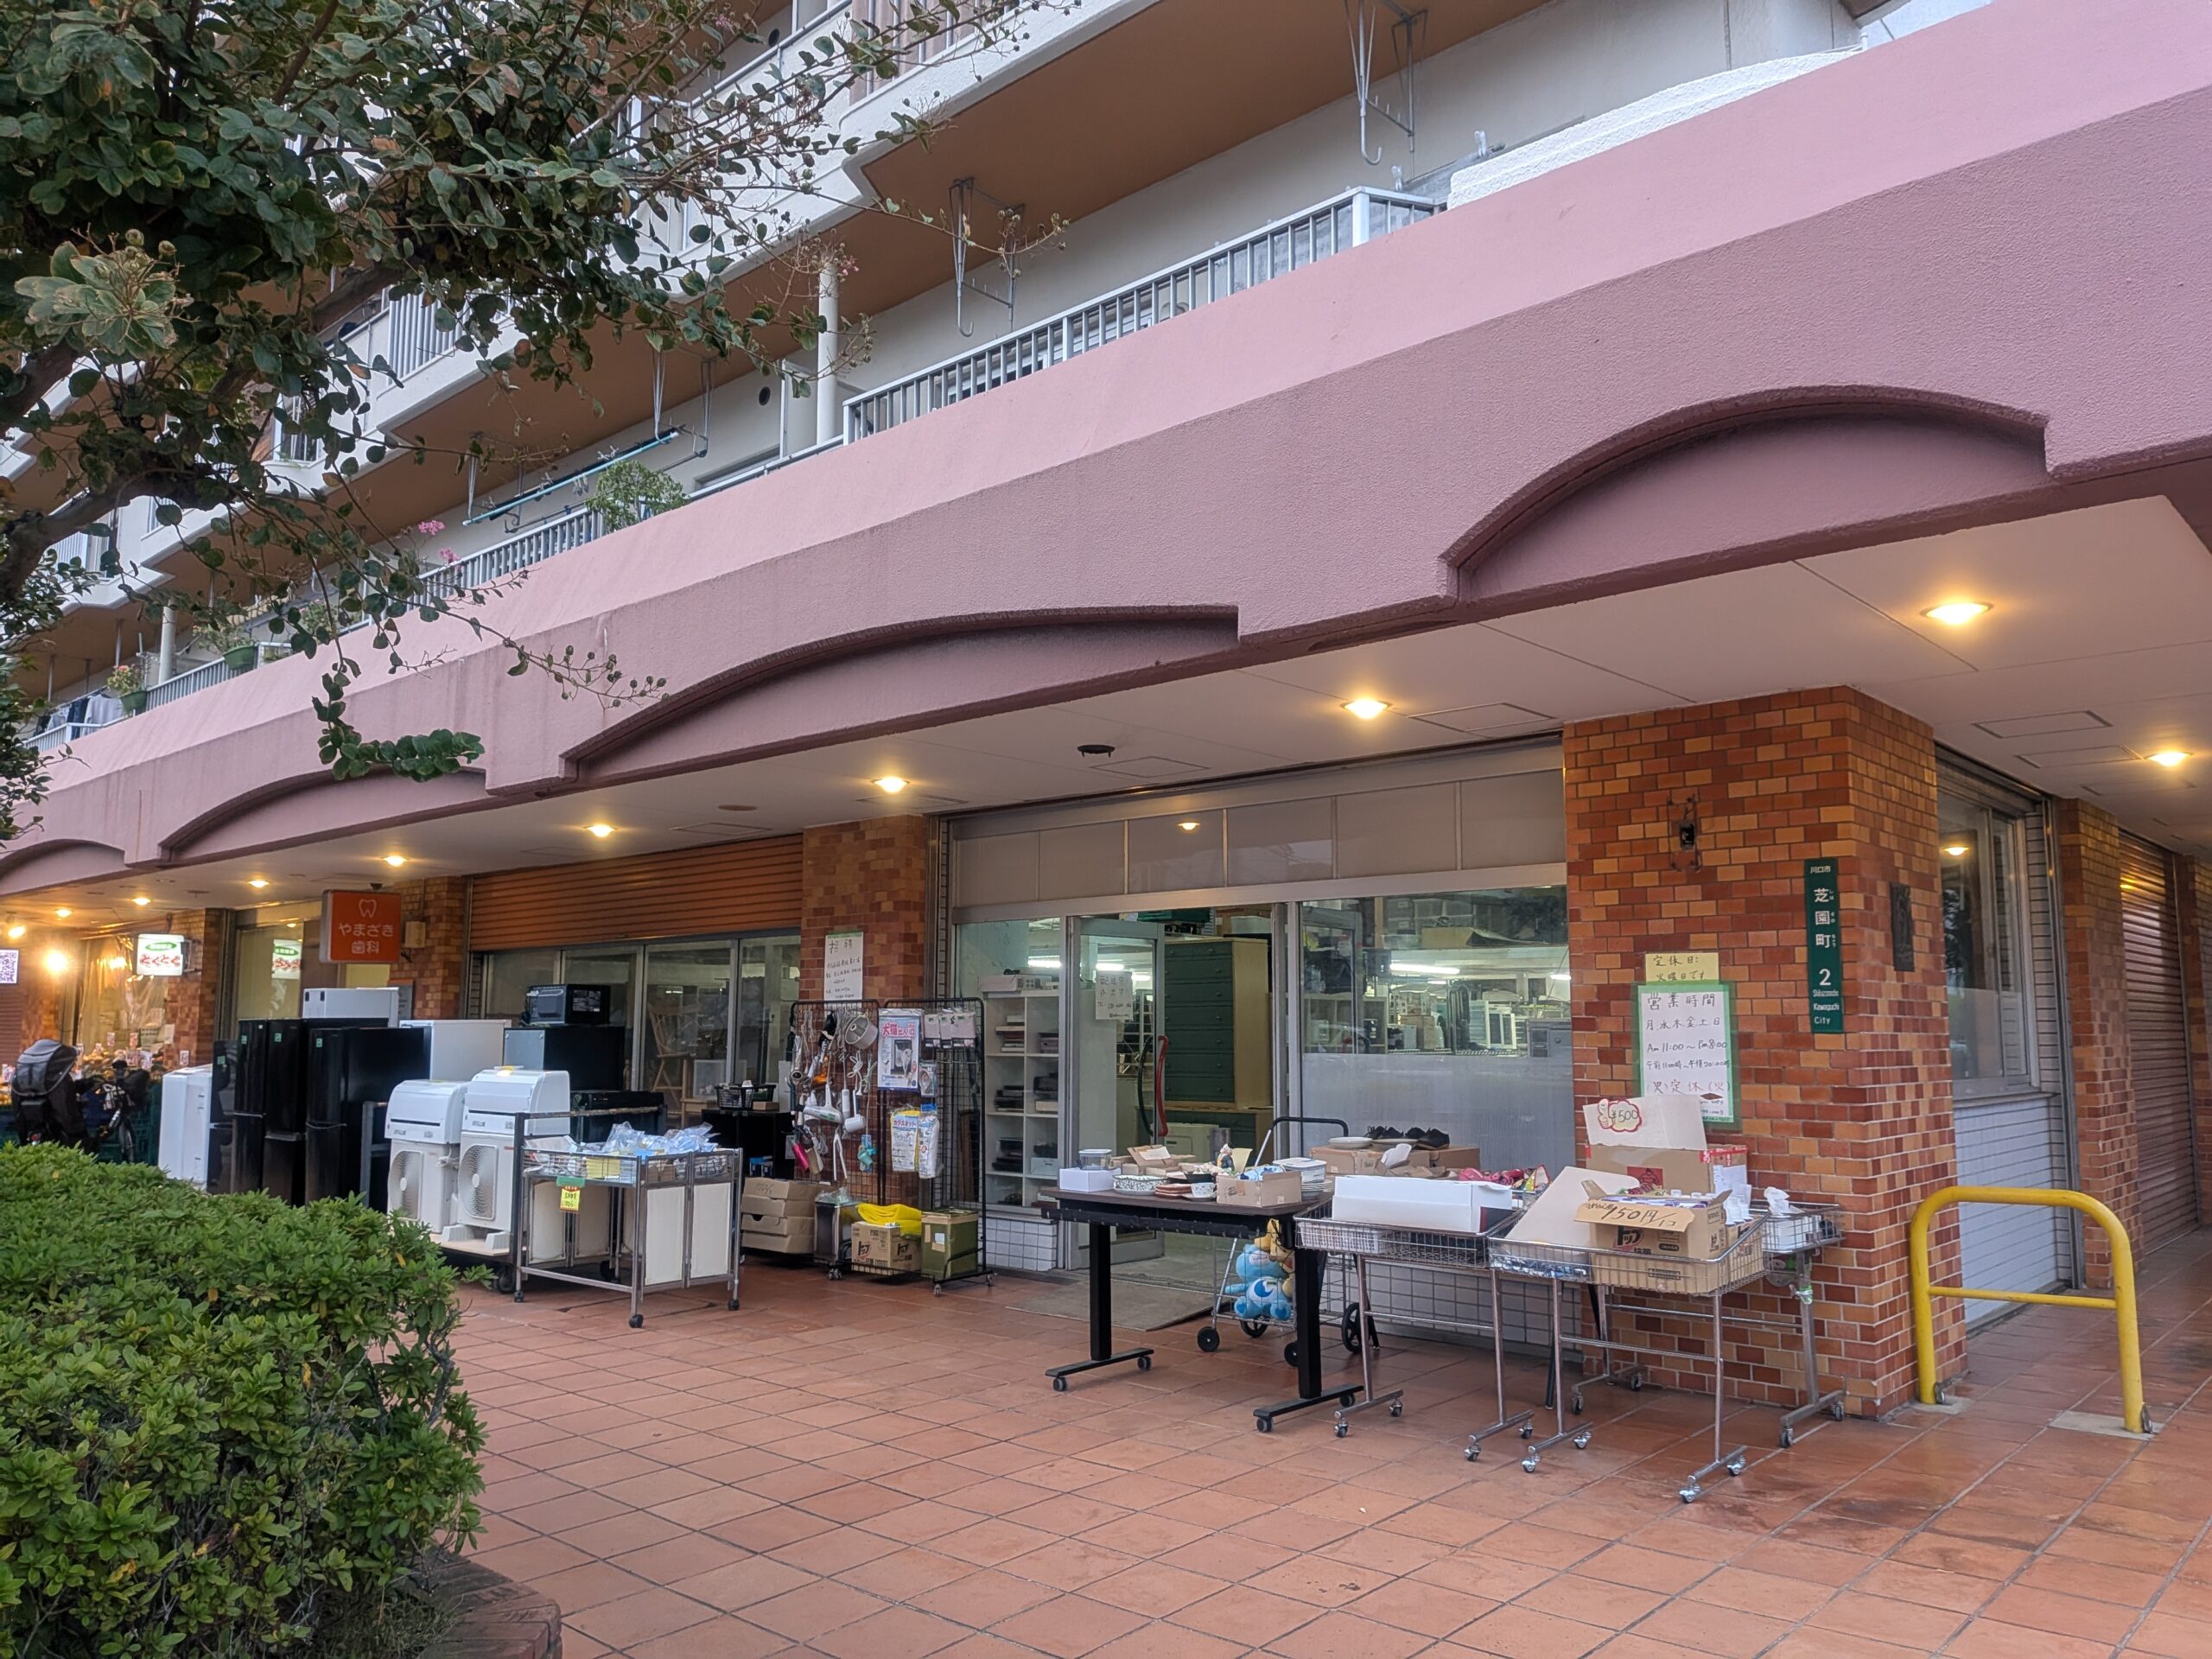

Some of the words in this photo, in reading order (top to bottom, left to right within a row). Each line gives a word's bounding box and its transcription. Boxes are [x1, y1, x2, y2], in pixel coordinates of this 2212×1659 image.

[1814, 887, 1832, 949] 芝園町
[338, 923, 395, 938] やまざき
[351, 940, 380, 955] 歯科
[139, 953, 181, 968] とくとく
[1819, 968, 1832, 986] 2
[1647, 991, 1715, 1011] 営業時間
[1814, 1016, 1831, 1025] City
[1610, 1109, 1639, 1123] ¥500
